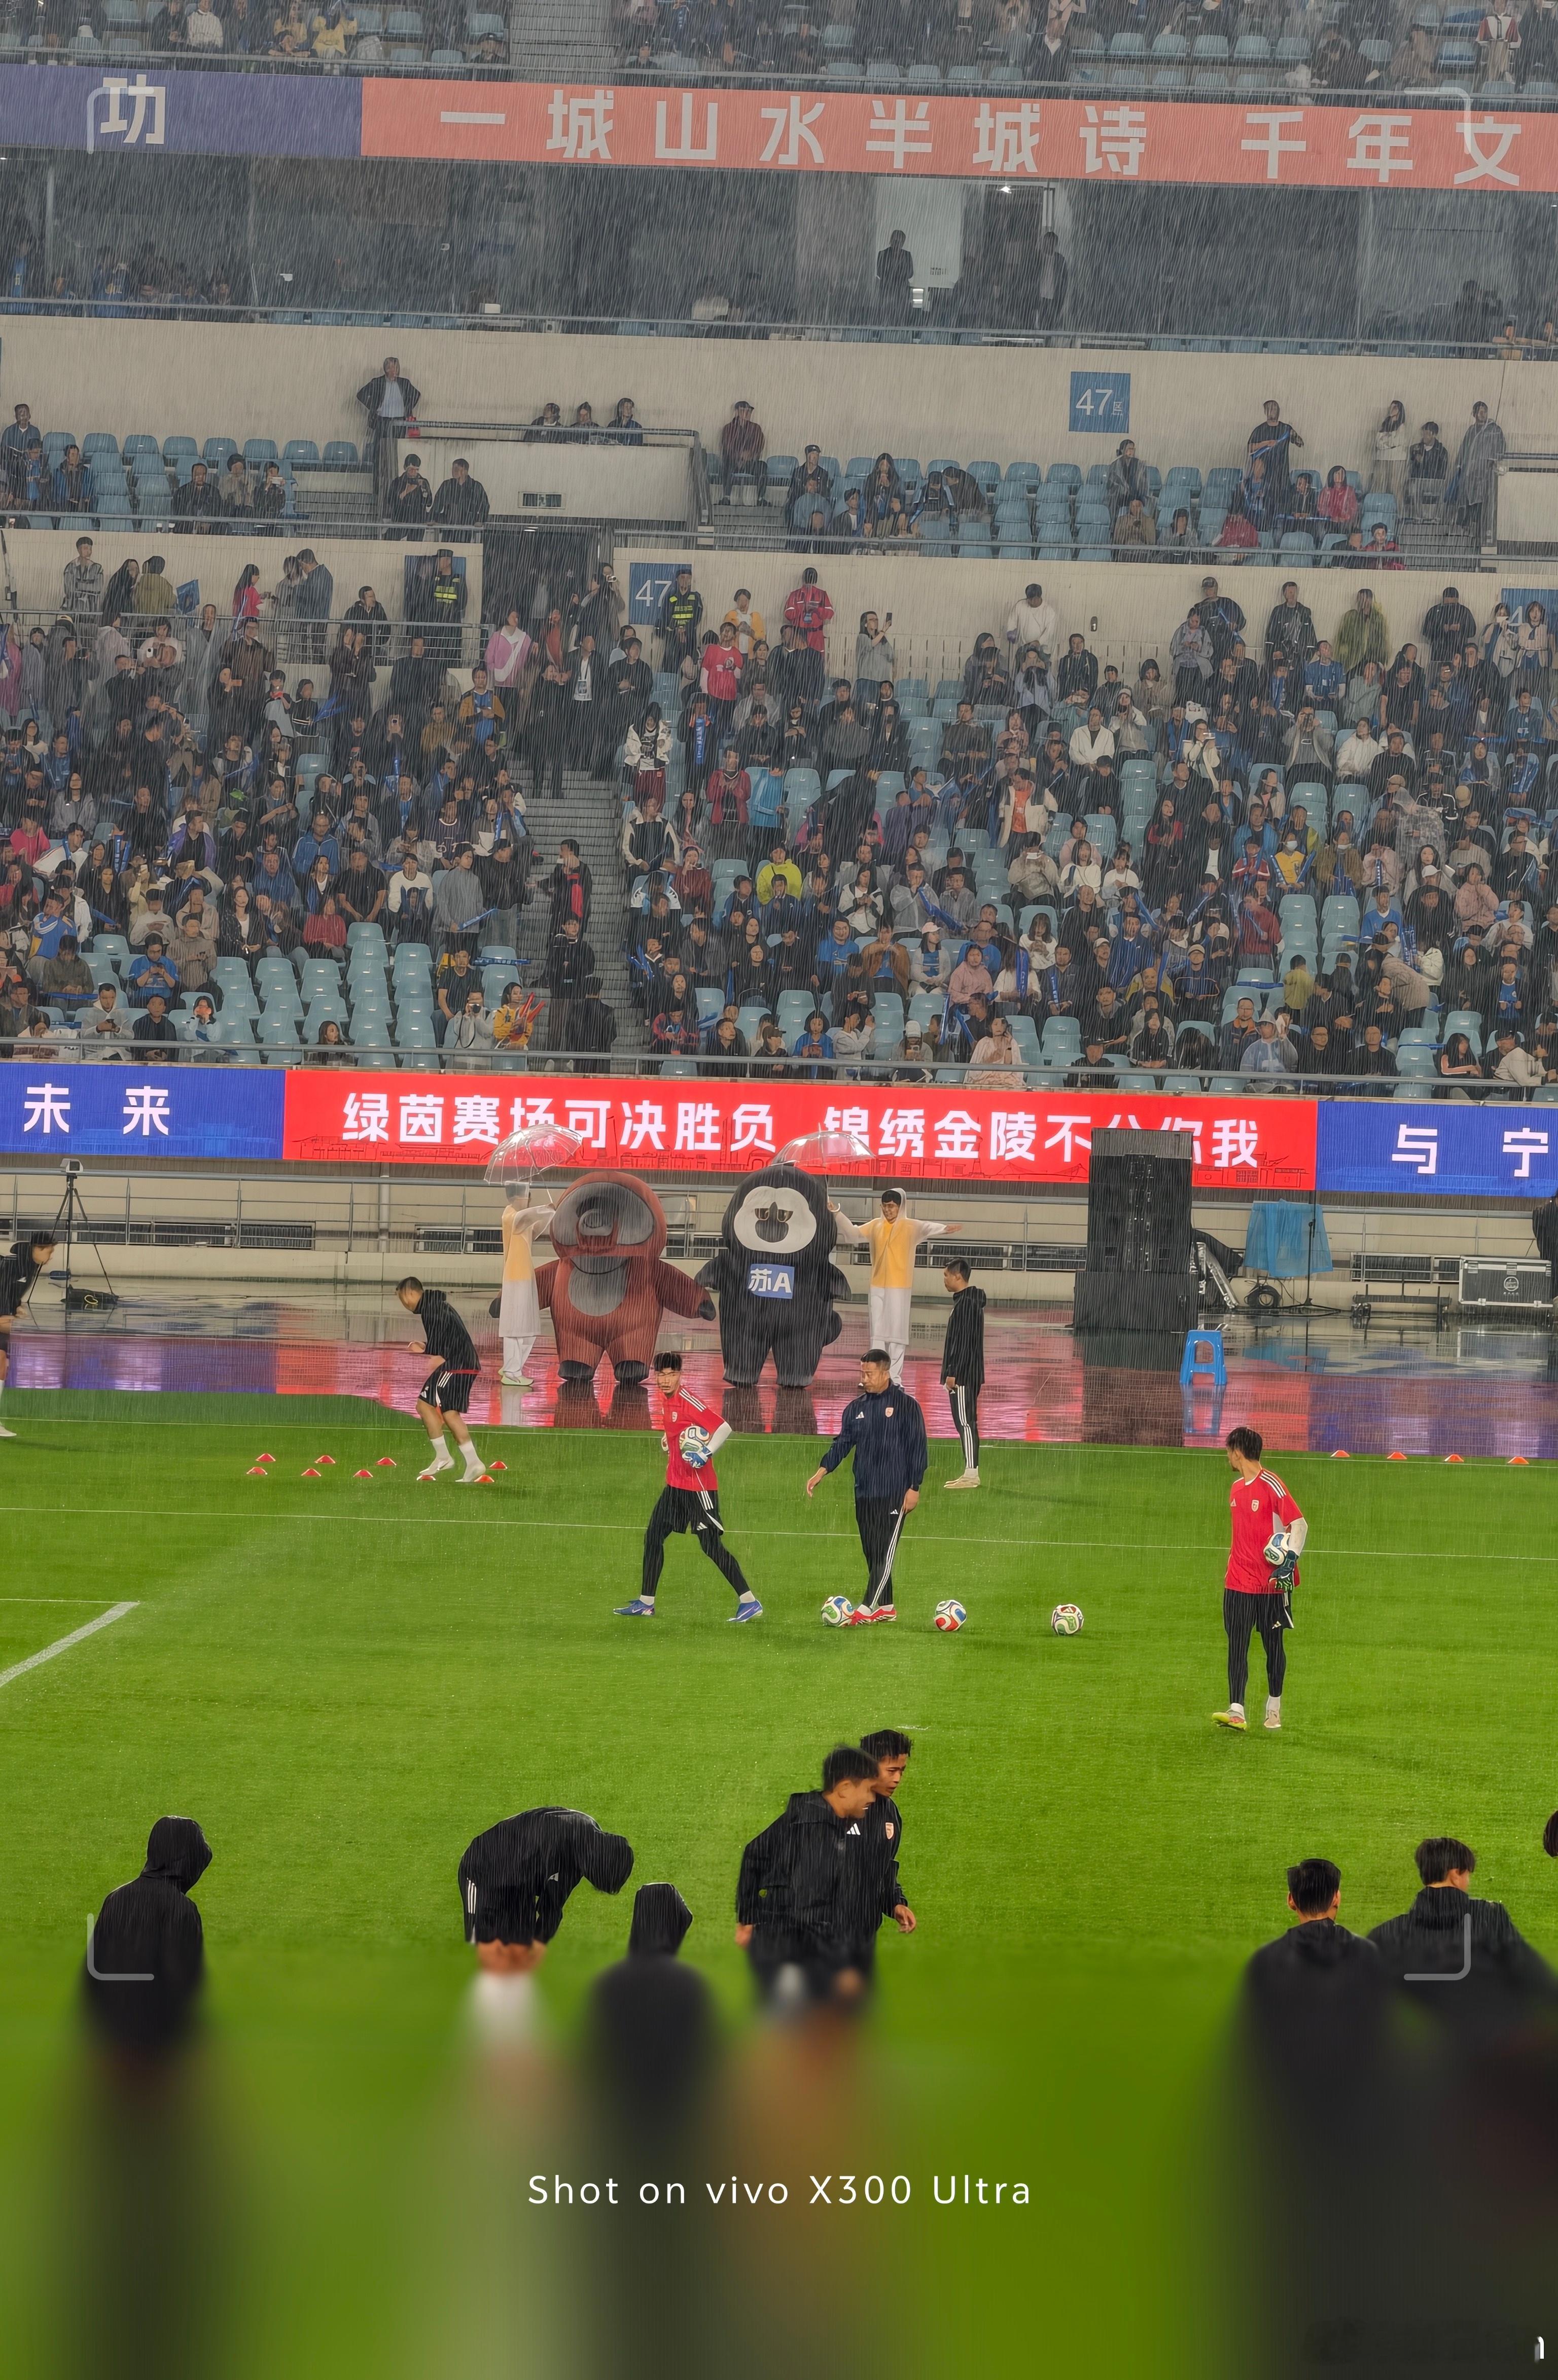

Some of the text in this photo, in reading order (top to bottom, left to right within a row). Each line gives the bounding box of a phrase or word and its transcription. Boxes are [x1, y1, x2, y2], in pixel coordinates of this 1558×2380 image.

[100, 74, 166, 145] 功
[440, 89, 1522, 186] 一城山水半城诗 千年文
[635, 579, 672, 607] 47
[23, 1082, 170, 1136] 未来
[342, 1092, 1258, 1168] 绿茵赛场可决胜负 锦绣金陵不我
[1392, 1124, 1549, 1177] 与宁
[748, 1268, 792, 1293] 苏A
